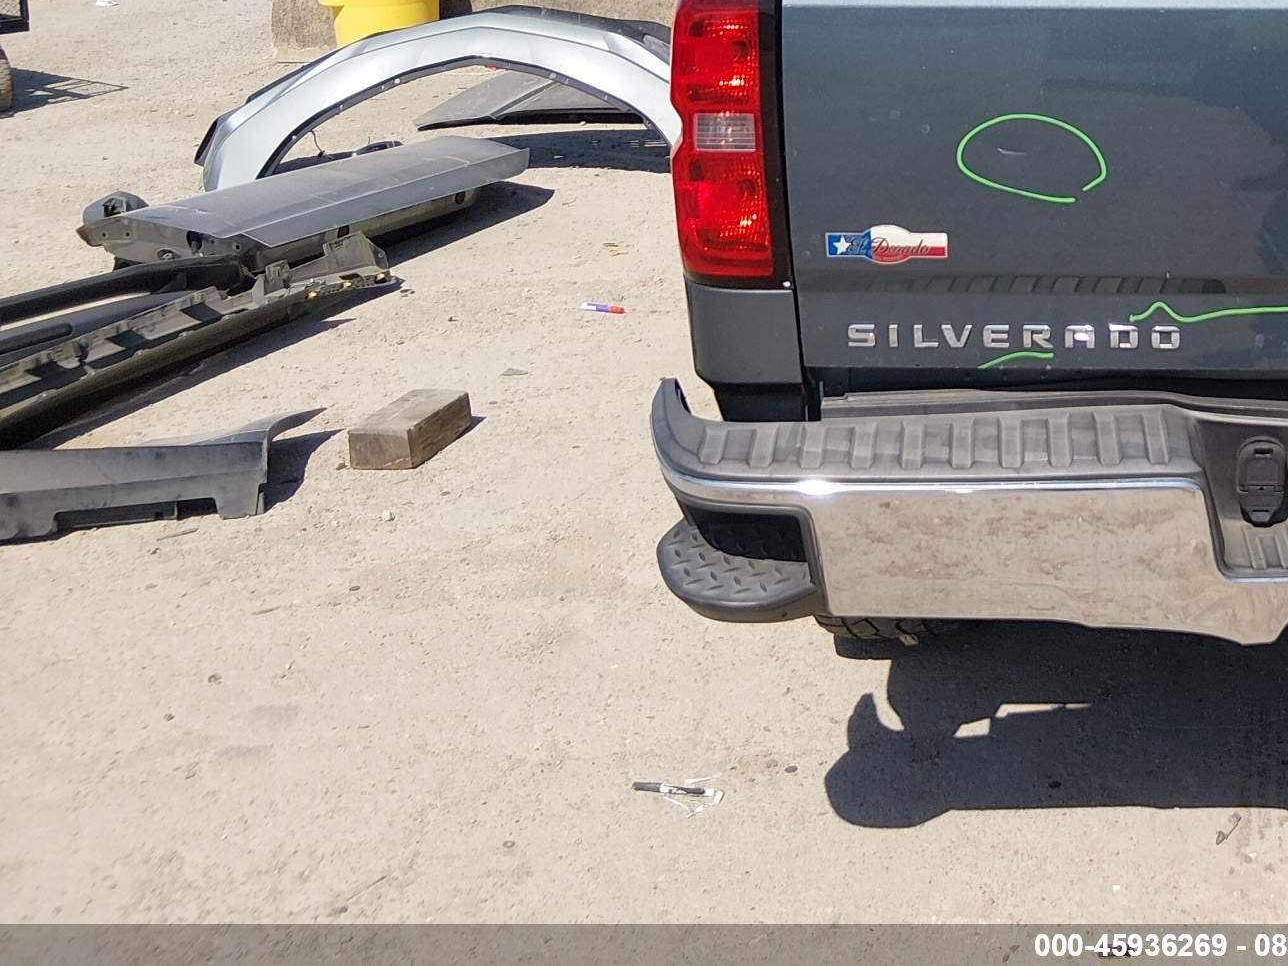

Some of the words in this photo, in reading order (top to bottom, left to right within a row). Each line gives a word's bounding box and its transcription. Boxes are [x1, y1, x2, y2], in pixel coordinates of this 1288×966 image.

[847, 235, 868, 254] El
[870, 236, 930, 255] Dorado
[847, 323, 1181, 349] SILVERADO
